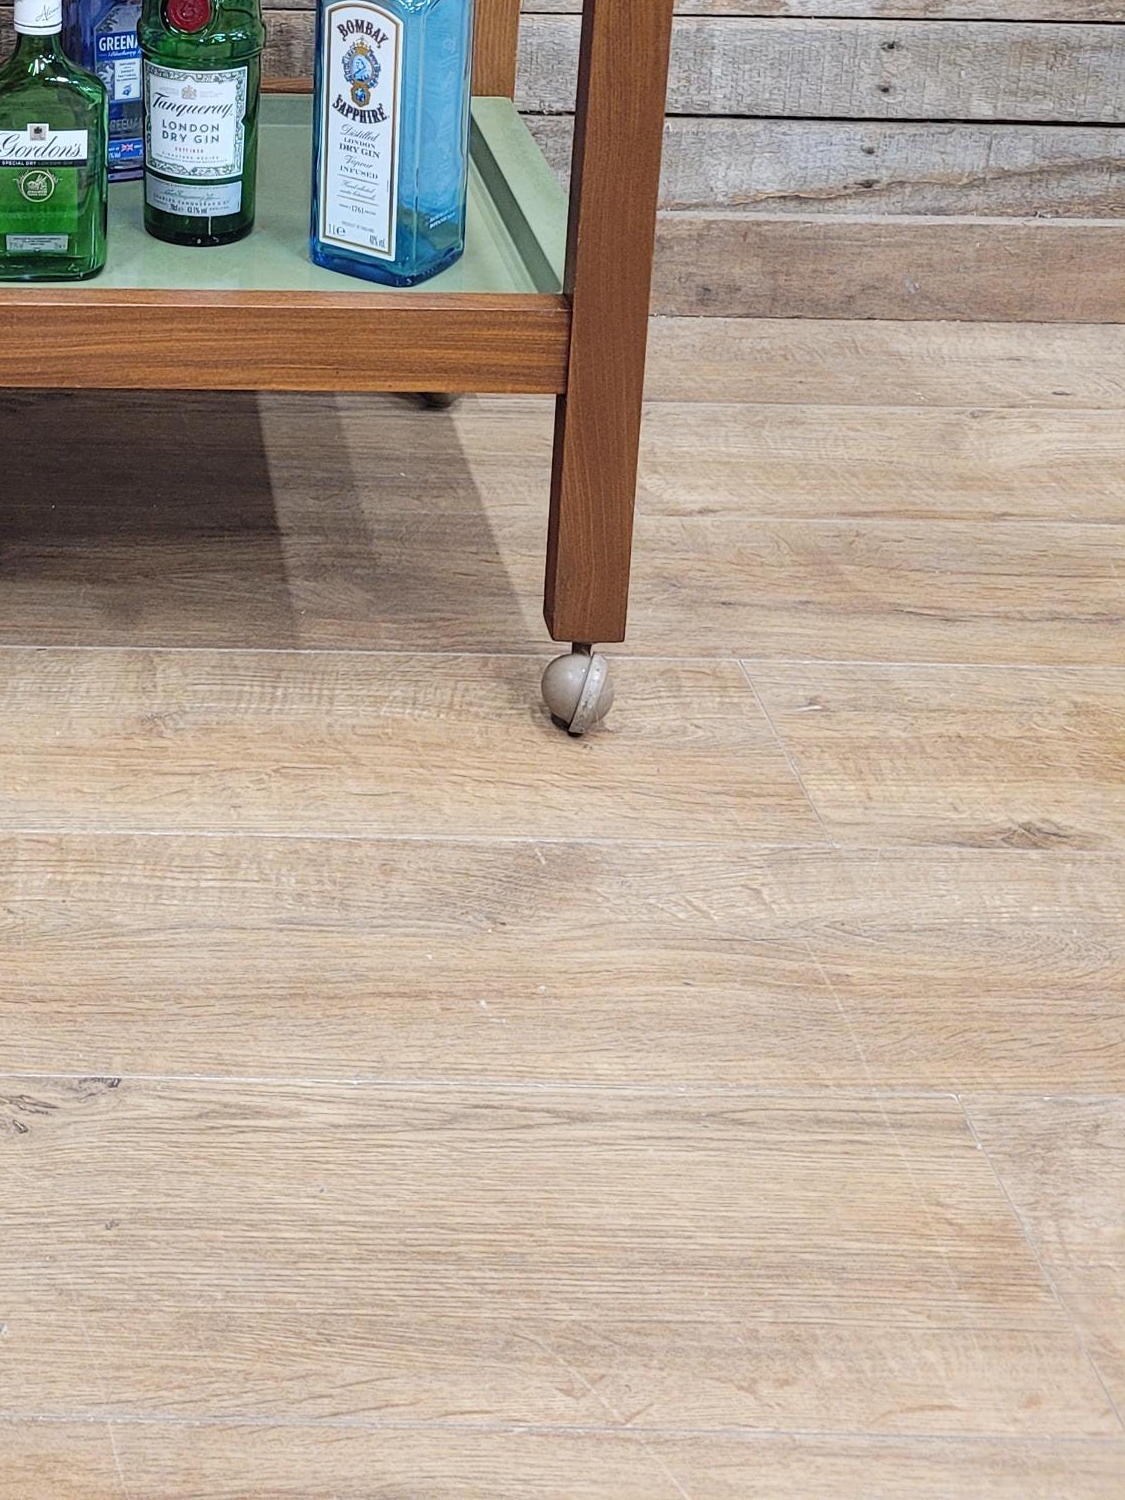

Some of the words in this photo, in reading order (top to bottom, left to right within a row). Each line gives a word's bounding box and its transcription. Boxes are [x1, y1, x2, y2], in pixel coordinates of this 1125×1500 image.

[337, 19, 389, 49] BOMBAY
[152, 91, 234, 119] Tanqueray
[332, 94, 388, 124] SAPPHIRE
[162, 119, 220, 133] LONDON
[162, 130, 188, 144] DRY
[194, 134, 220, 144] GIN
[343, 137, 377, 150] LONDON
[339, 142, 360, 154] DRY
[360, 147, 381, 160] GIN
[340, 165, 379, 180] INFUSED
